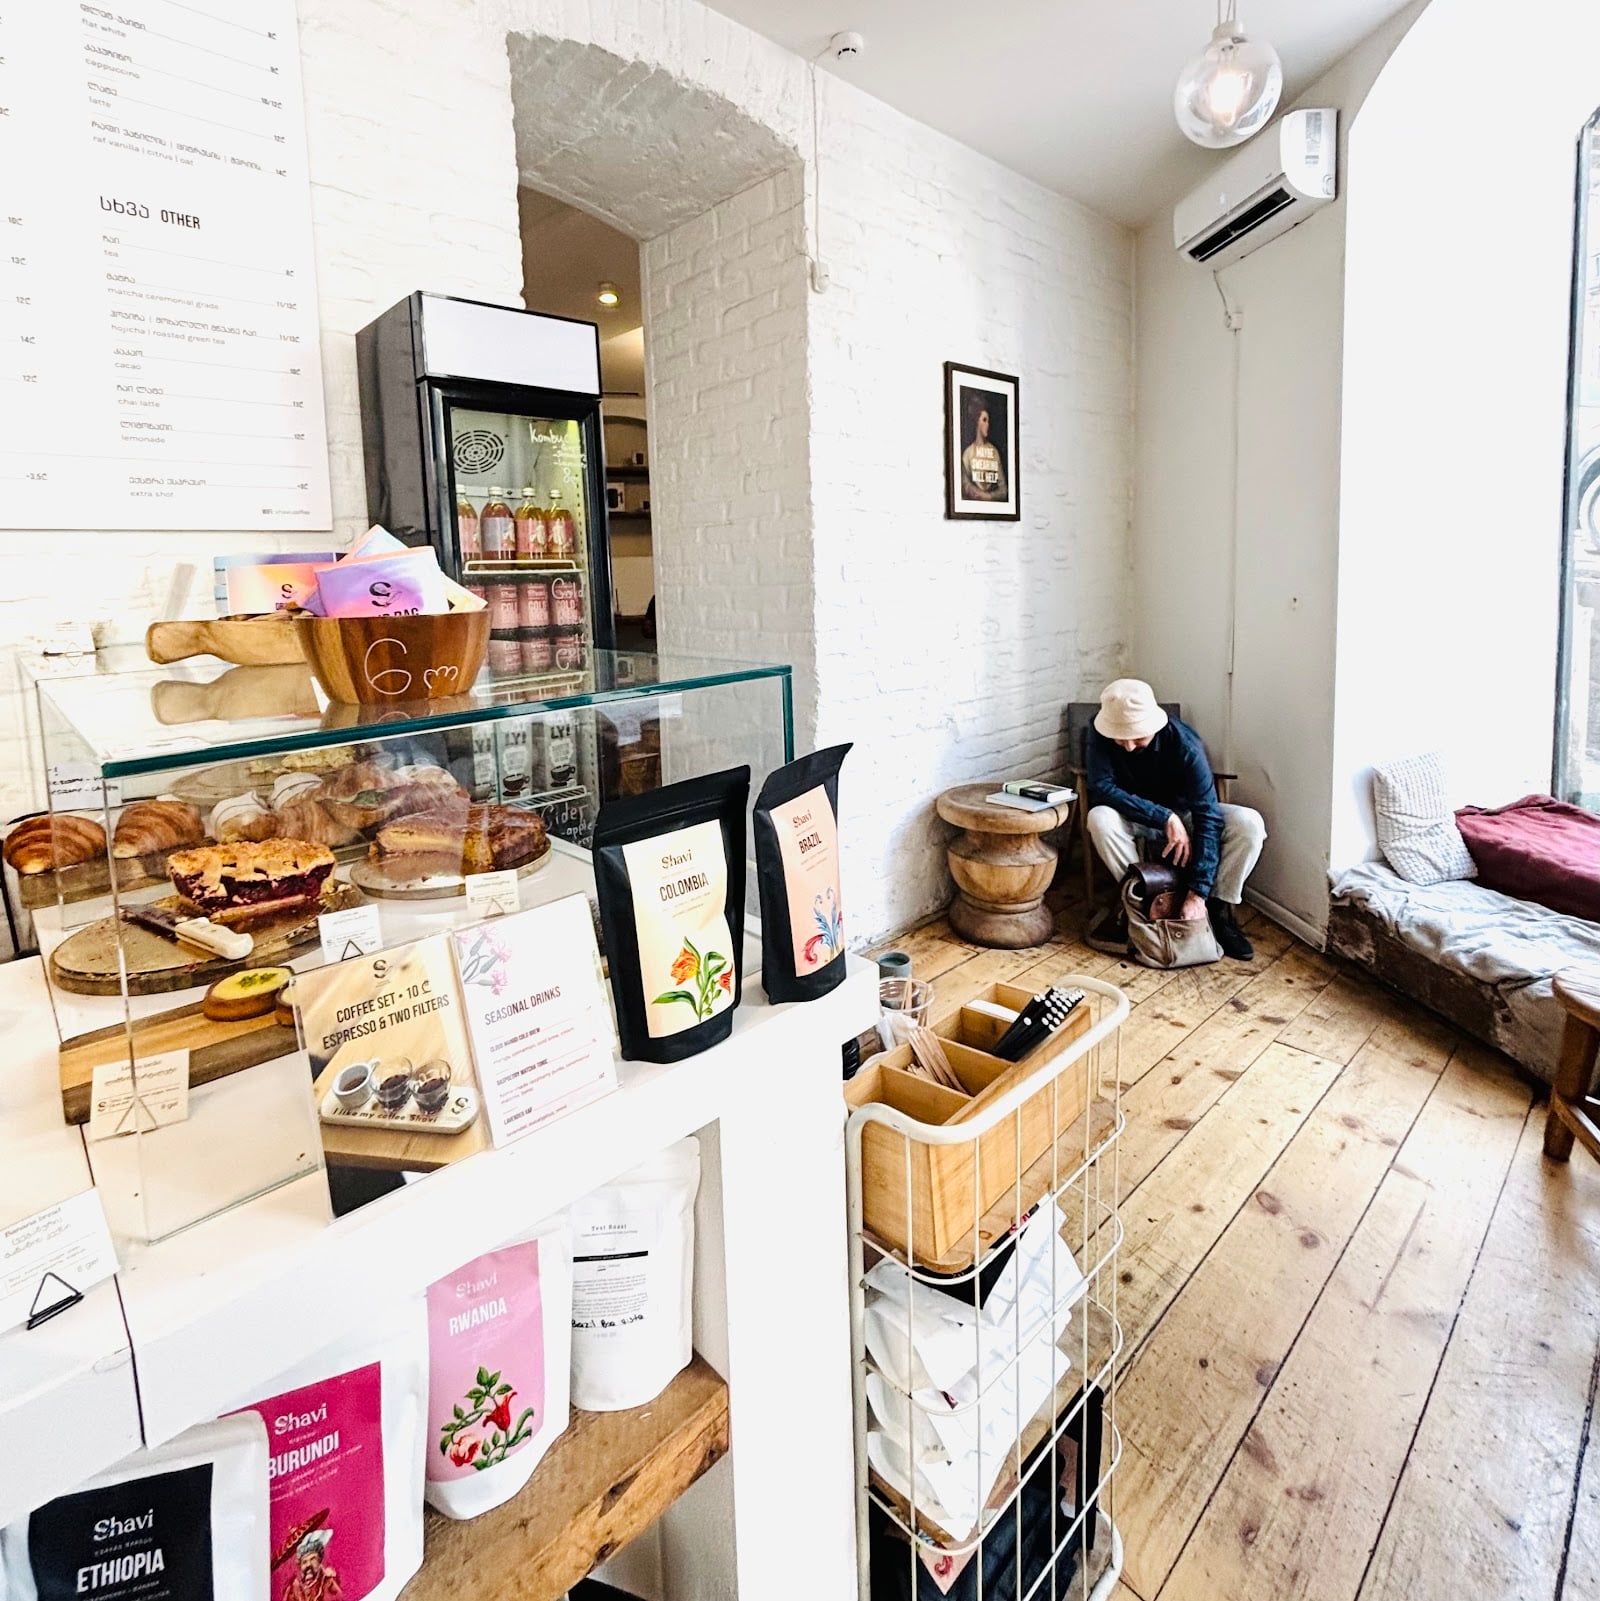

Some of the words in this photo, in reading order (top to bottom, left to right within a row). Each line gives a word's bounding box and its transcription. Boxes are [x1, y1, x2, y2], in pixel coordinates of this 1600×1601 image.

[85, 57, 141, 79] cappuccino
[88, 96, 112, 109] latte
[92, 135, 107, 146] raf
[109, 139, 140, 154] vanilla
[147, 148, 174, 162] citrus
[179, 157, 195, 166] oat
[99, 195, 150, 219] სხვა
[160, 208, 201, 230] OTHER
[104, 249, 119, 258] tea
[107, 287, 144, 299] matcha
[145, 293, 195, 306] ceremonial
[195, 300, 220, 311] grade
[111, 323, 146, 336] hojicha
[153, 330, 186, 341] roasted
[187, 335, 212, 344] green
[212, 337, 226, 345] tea
[114, 361, 142, 370] cacao
[118, 398, 140, 408] chai
[141, 399, 161, 408] latte
[121, 434, 166, 444] lemonade
[130, 490, 153, 498] extra
[154, 490, 175, 498] shot
[364, 637, 411, 695] 6
[541, 801, 588, 831] Cider
[792, 808, 812, 828] Shavi
[798, 831, 823, 855] BRAZIL
[661, 848, 692, 870] Shavi
[659, 872, 710, 902] COLOMBIA
[336, 998, 376, 1023] COFFEE
[377, 992, 396, 1010] SET
[406, 984, 419, 1000] 10
[484, 1000, 530, 1026] SEASONAL
[530, 986, 562, 1008] DRINKS
[322, 1019, 378, 1050] ESPRESSO
[379, 1016, 387, 1030] &
[388, 1007, 411, 1027] TWO
[413, 993, 450, 1018] FILTERS
[338, 1107, 358, 1117] like
[359, 1110, 375, 1119] my
[377, 1111, 406, 1121] coffee
[455, 1271, 498, 1299] Shavi
[448, 1296, 508, 1337] RWANDA
[274, 1402, 328, 1436] Shavi
[267, 1429, 340, 1480] BURUNDI
[93, 1507, 154, 1542] Shavi
[76, 1547, 165, 1594] ETHIOPIA
